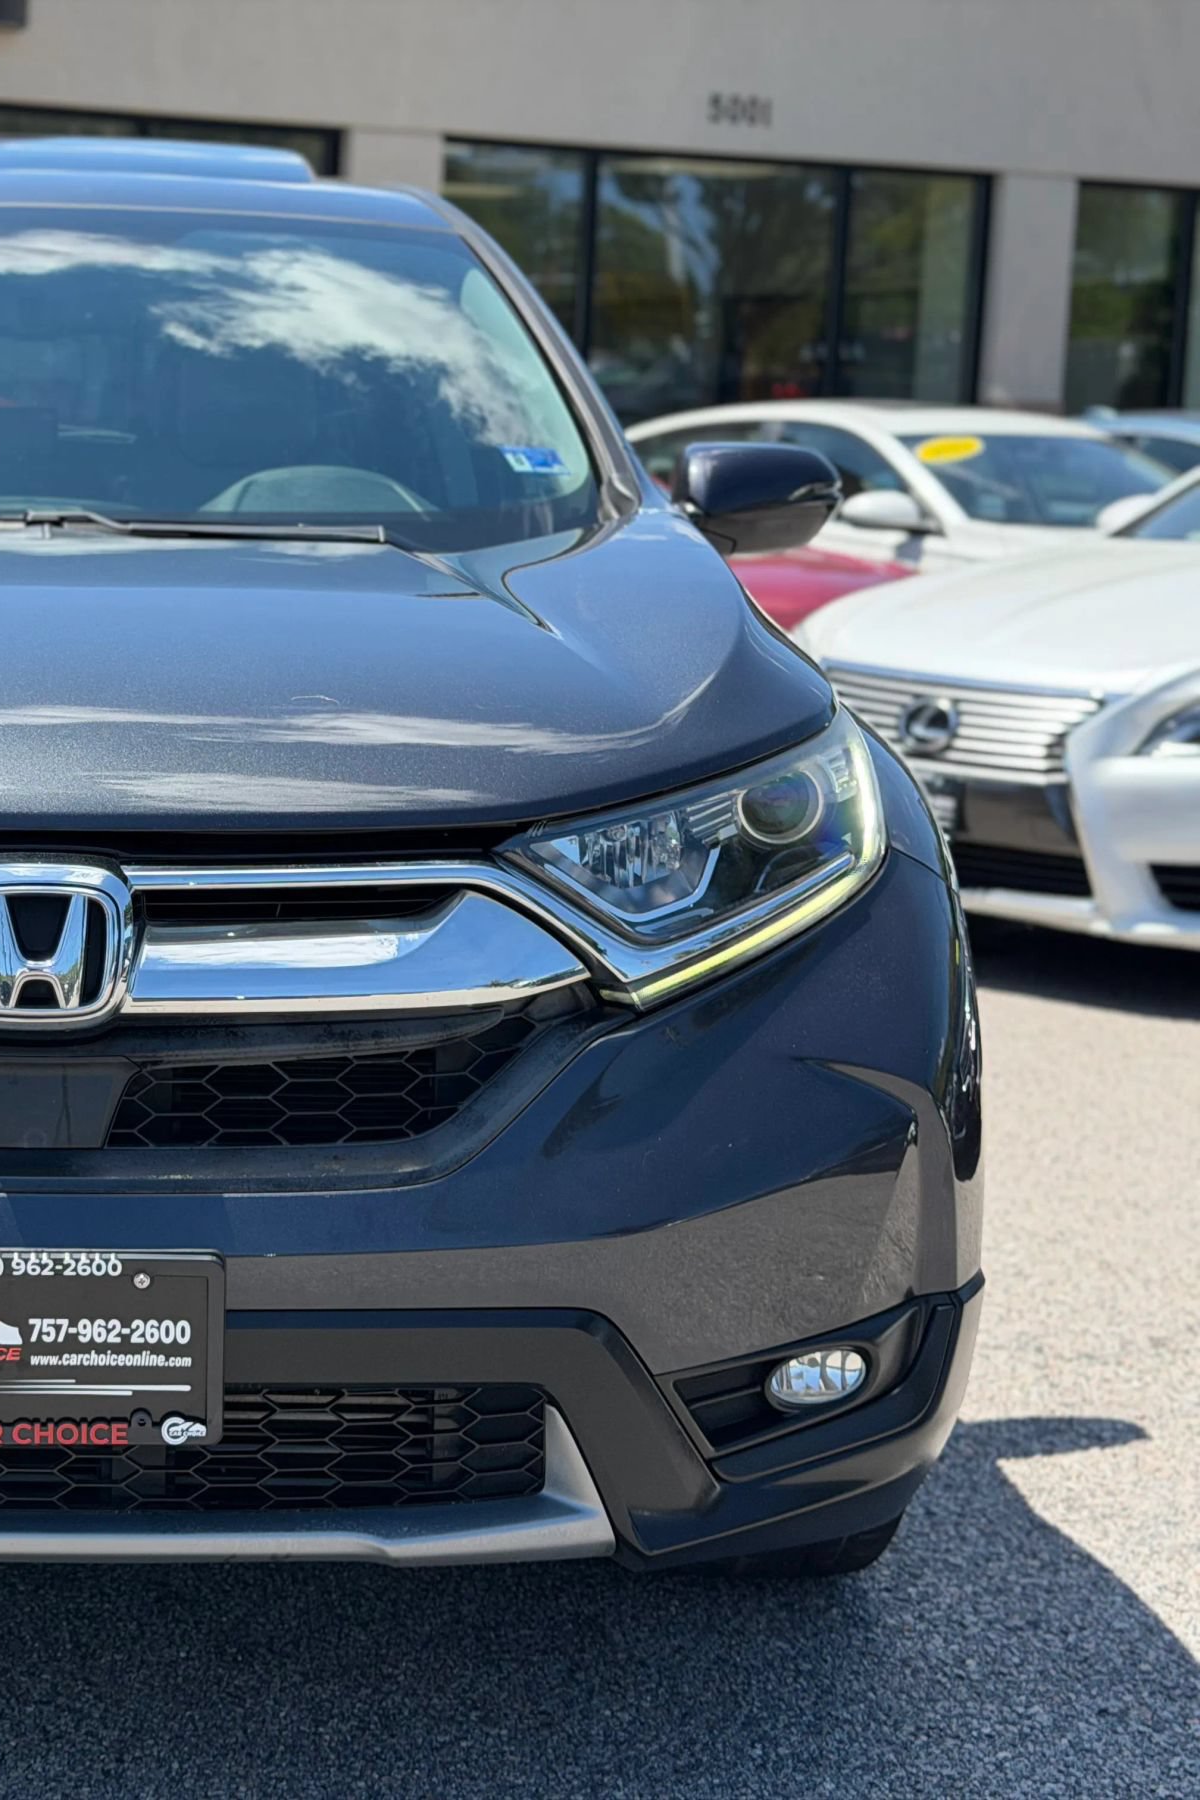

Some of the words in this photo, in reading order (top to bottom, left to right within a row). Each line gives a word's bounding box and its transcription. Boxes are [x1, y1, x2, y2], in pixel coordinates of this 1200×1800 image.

[11, 1256, 123, 1276] 962-2600
[28, 1318, 192, 1345] 757-962-2600
[30, 1350, 193, 1367] www.carchoiceonline.com
[12, 1423, 129, 1445] CHOICE
